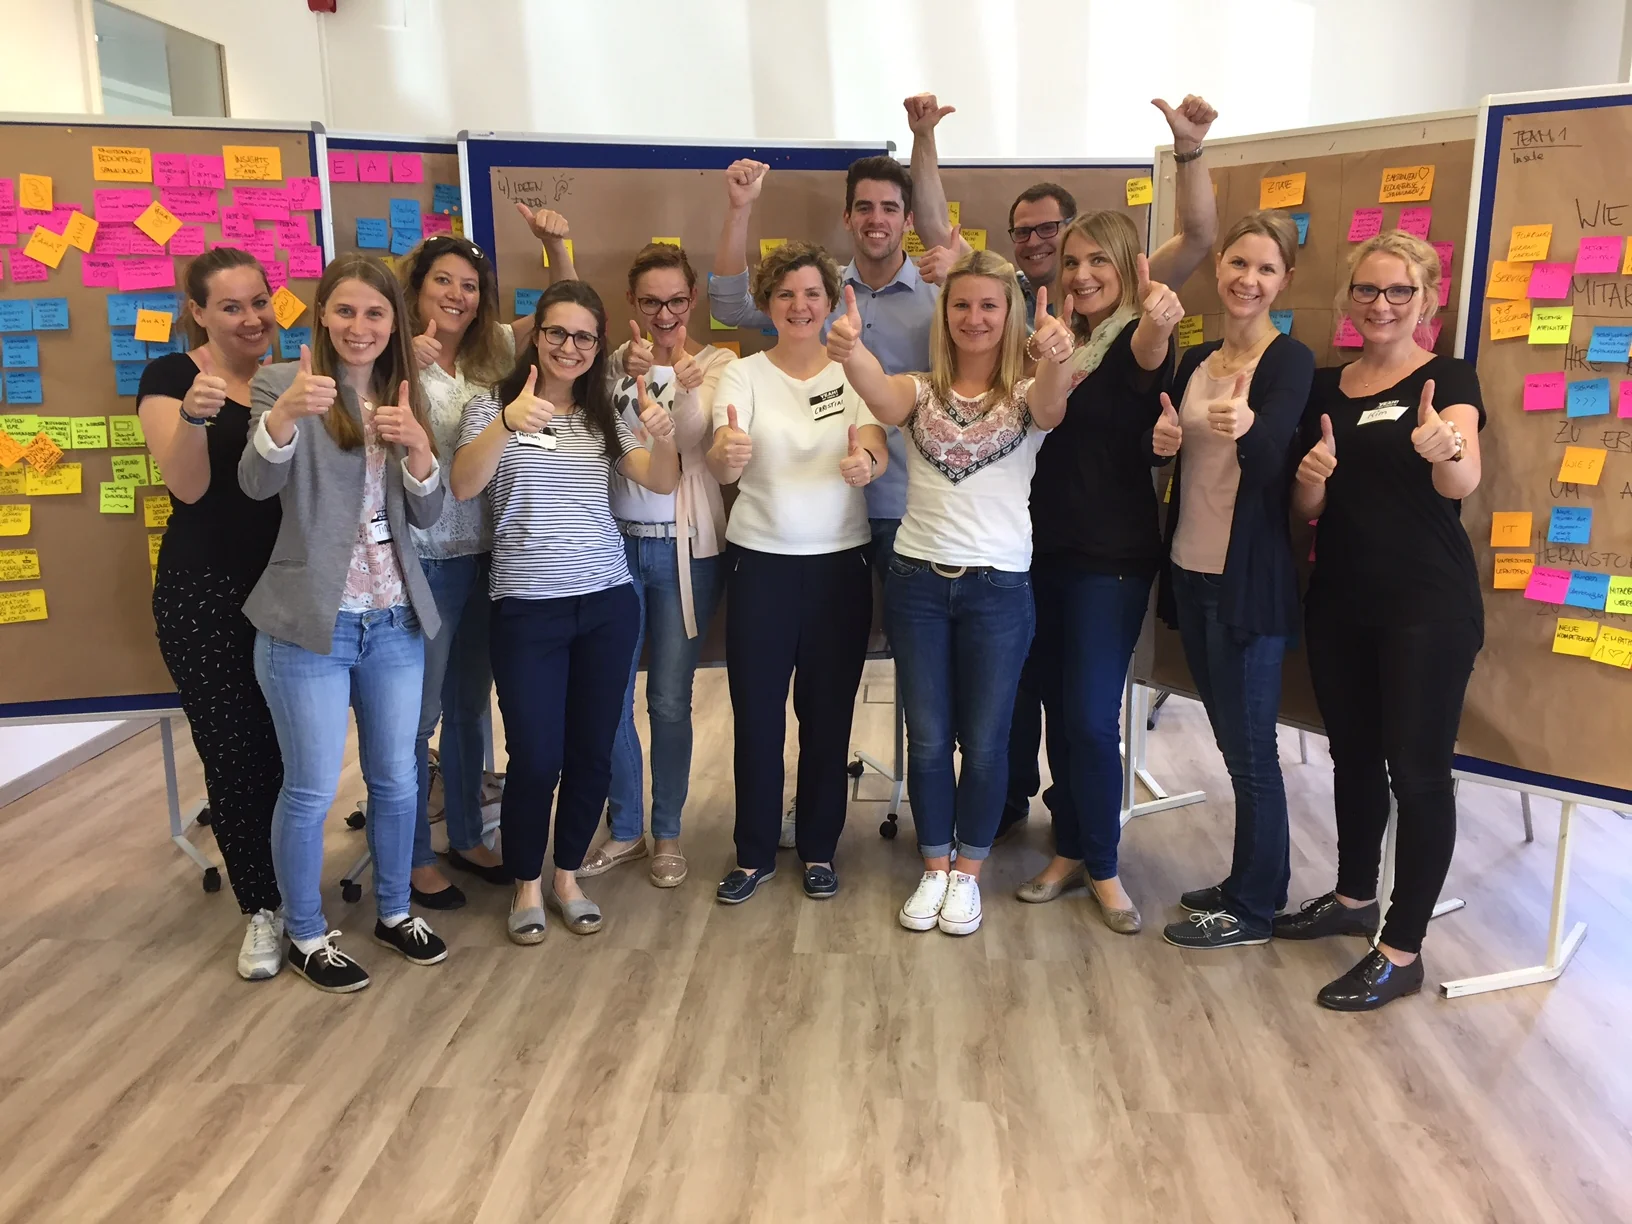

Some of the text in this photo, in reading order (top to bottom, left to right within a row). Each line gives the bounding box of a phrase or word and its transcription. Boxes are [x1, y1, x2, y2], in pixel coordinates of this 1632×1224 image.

[1558, 127, 1567, 141] 1
[513, 180, 544, 194] IDEEN
[1575, 198, 1629, 229] WIE
[1554, 420, 1581, 444] ZU
[1600, 430, 1632, 450] ER
[1564, 460, 1583, 469] WIE
[1558, 624, 1580, 632] NEUE
